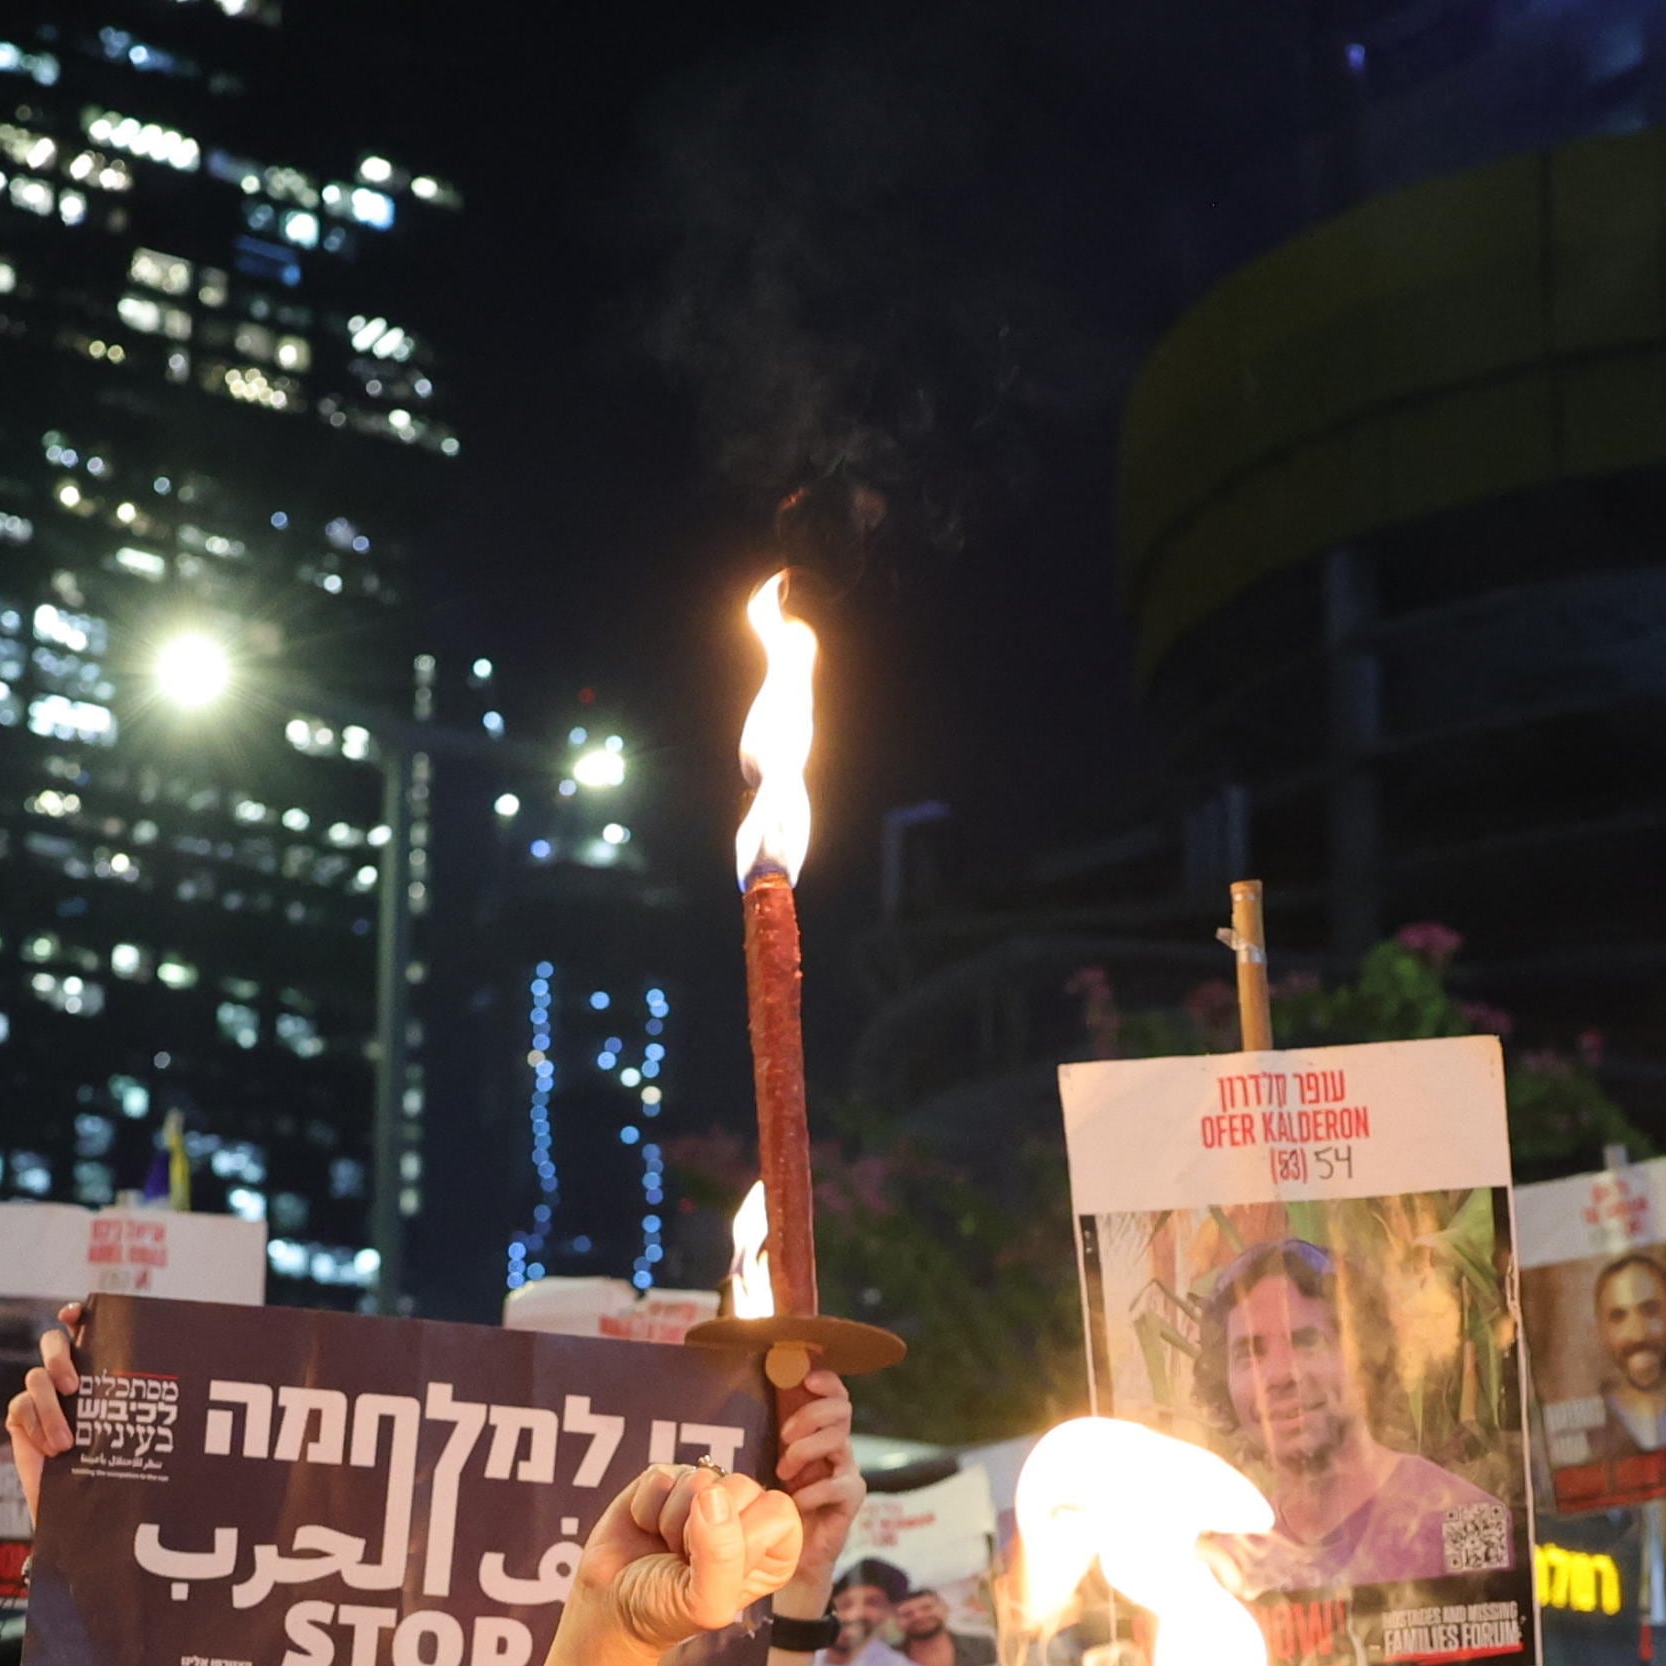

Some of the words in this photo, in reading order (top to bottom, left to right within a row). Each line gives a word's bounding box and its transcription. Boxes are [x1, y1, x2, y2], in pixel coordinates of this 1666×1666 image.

[1216, 1072, 1287, 1112] קלדרון
[1293, 1068, 1346, 1105] עופר
[1201, 1113, 1256, 1149] OFER
[1262, 1106, 1371, 1143] KALDERON
[1314, 1144, 1353, 1180] 54
[79, 1368, 179, 1402] מסתכלים
[77, 1398, 178, 1425] לכיבוש
[75, 1421, 174, 1457] בעיניים
[204, 1381, 625, 1545] למלחמה
[1442, 1604, 1467, 1623] AND
[1467, 1600, 1518, 1621] MISSING
[1383, 1624, 1460, 1655] FAMILIES
[1461, 1619, 1520, 1648] FORUM
